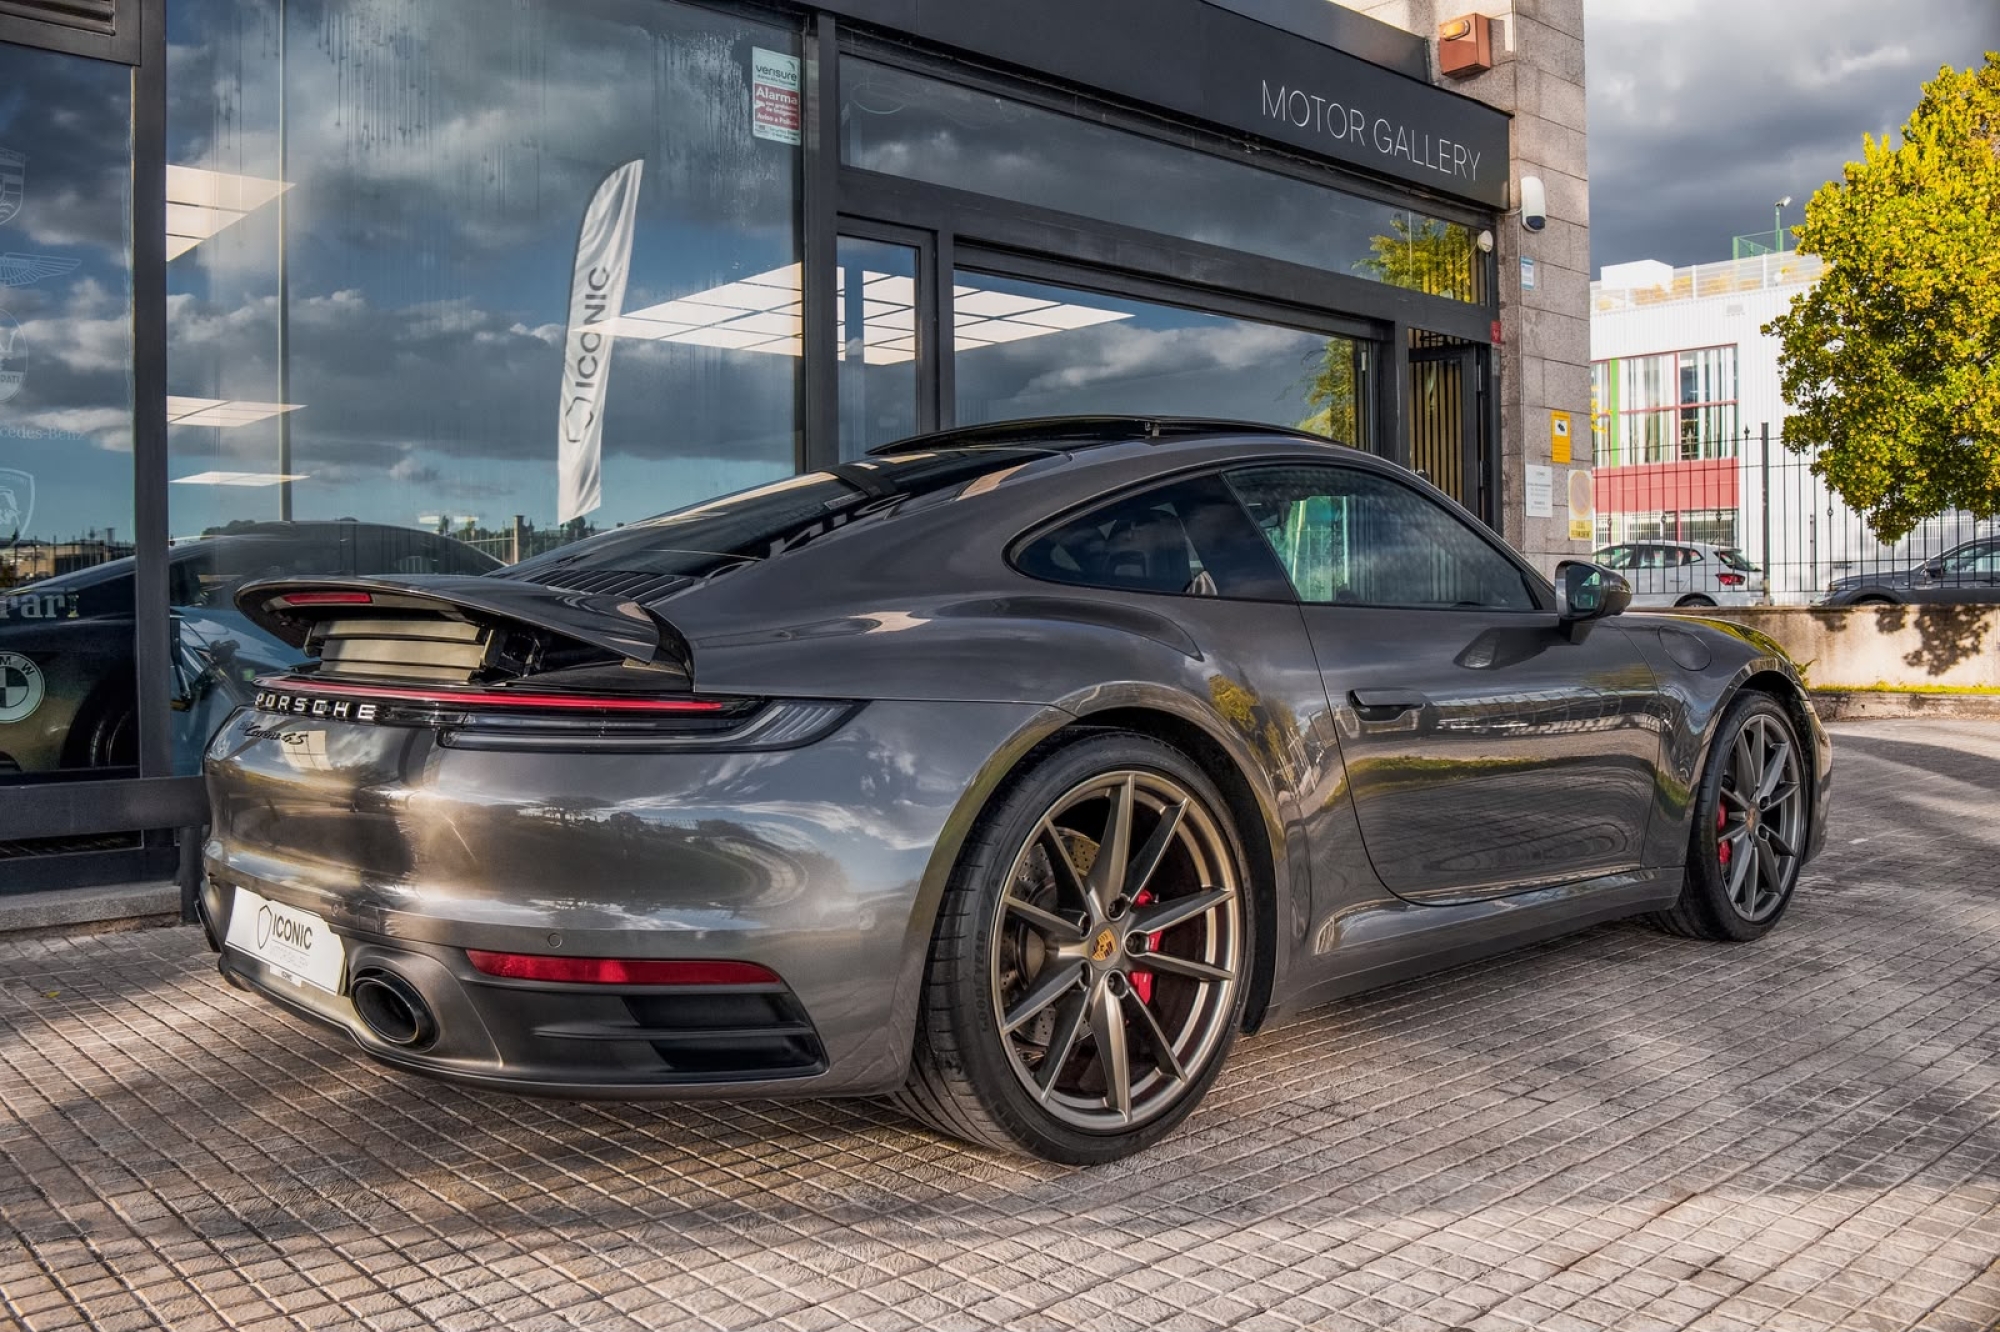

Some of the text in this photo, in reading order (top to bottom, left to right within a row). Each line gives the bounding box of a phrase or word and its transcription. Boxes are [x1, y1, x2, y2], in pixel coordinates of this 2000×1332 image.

[756, 86, 798, 105] Alarma
[1262, 79, 1481, 181] MOTOR GALLERY
[575, 265, 611, 389] ICONIC
[255, 692, 377, 720] PORSCHE
[272, 912, 313, 950] ICONIC
